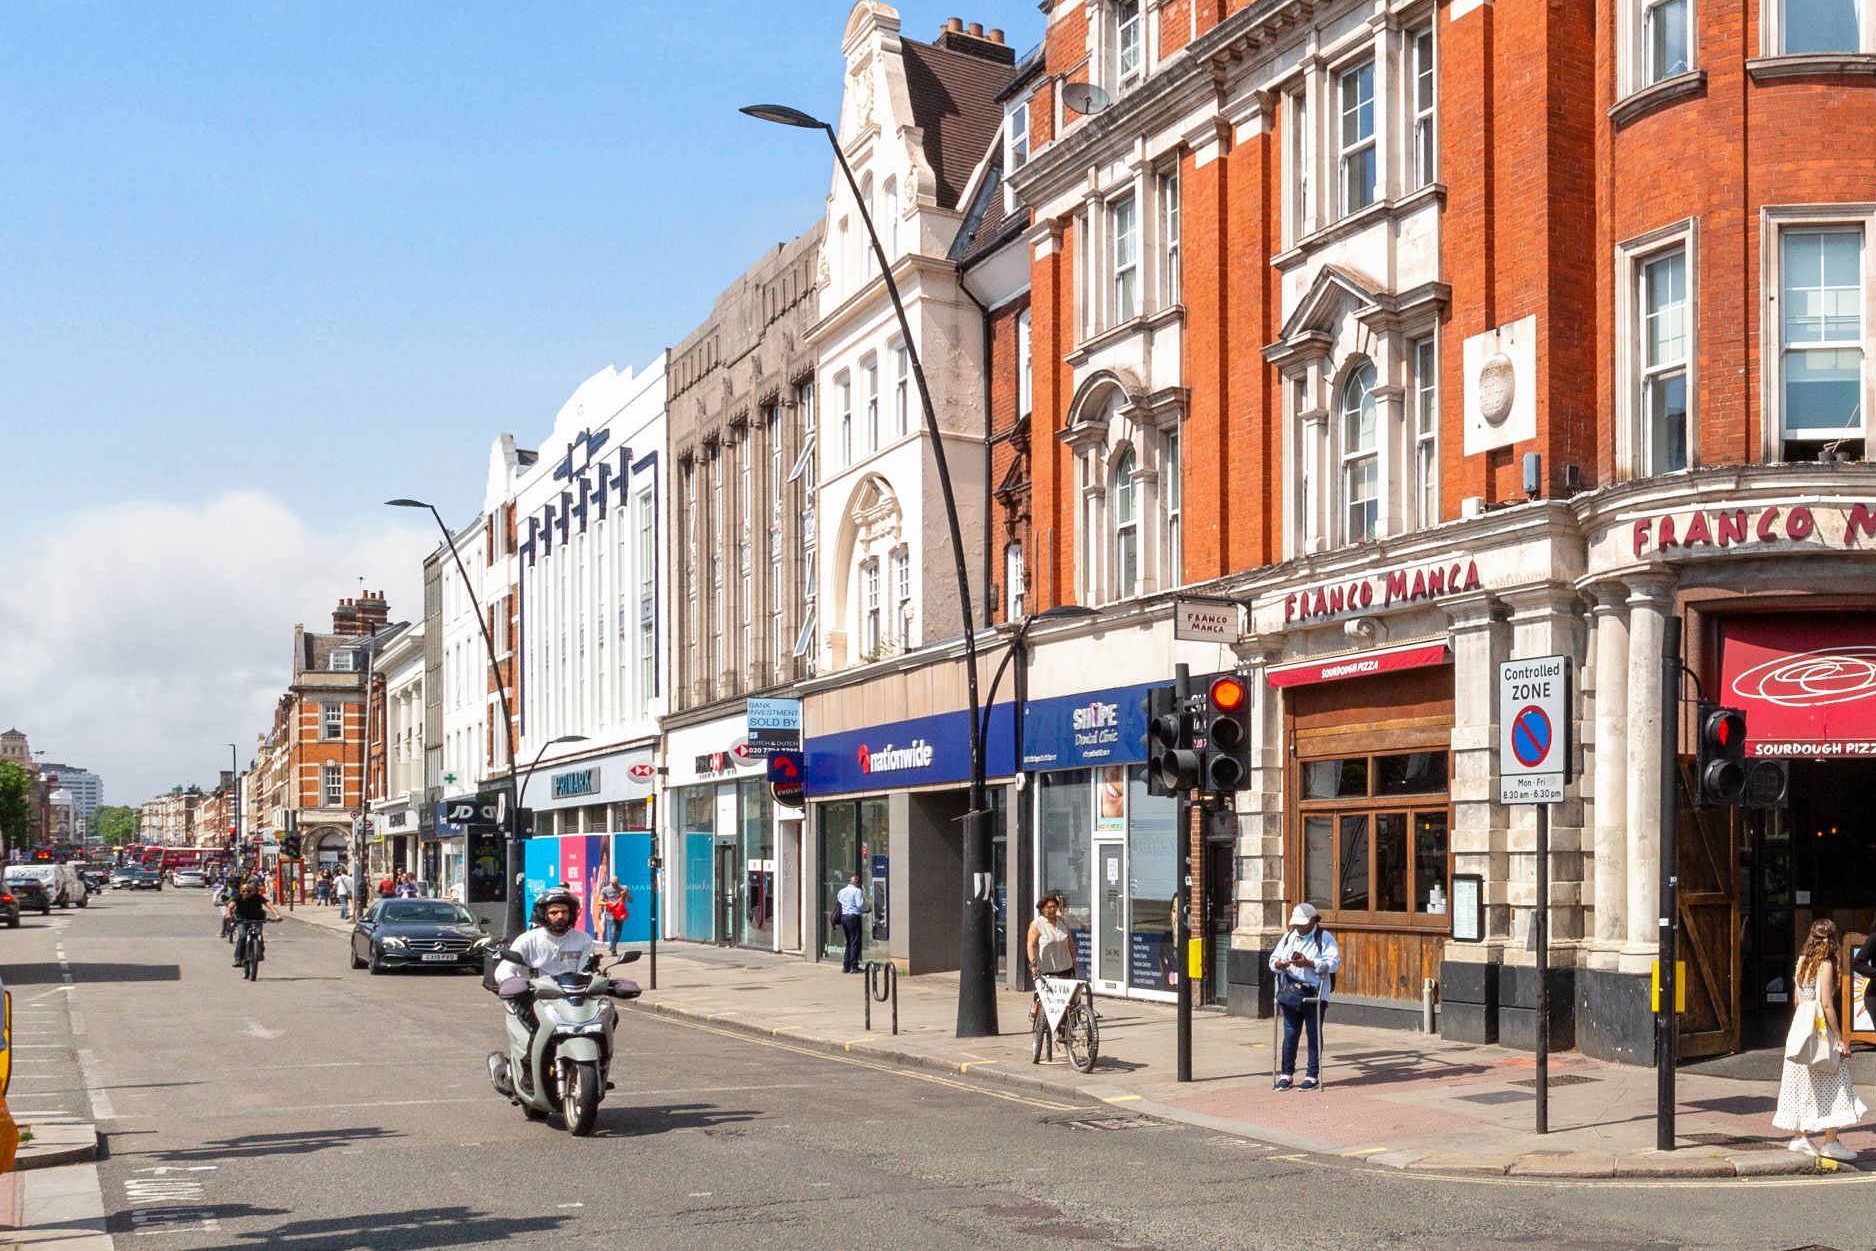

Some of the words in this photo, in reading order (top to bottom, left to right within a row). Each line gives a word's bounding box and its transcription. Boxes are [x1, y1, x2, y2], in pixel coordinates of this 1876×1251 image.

[1633, 506, 1813, 557] FRANCO
[1285, 581, 1373, 623] FRANCO
[1384, 560, 1481, 608] MANCA
[1187, 613, 1228, 623] FRANCO
[1191, 623, 1224, 633] MANCA
[1321, 662, 1358, 679] SOURDOUGH
[1358, 660, 1379, 673] PIZZA
[1504, 663, 1560, 681] Controlled
[1512, 682, 1551, 700] ZONE
[748, 709, 799, 717] INVESTMENT
[750, 718, 780, 727] SOLD
[783, 718, 798, 727] BY
[870, 739, 933, 773] nationwide
[1755, 743, 1842, 756] SOURDOUGH
[556, 769, 592, 797] PRIMARK
[1518, 779, 1532, 787] Mon
[1536, 778, 1546, 787] Fri
[1533, 789, 1550, 798] 6.30
[1550, 790, 1561, 800] pm
[449, 805, 474, 819] JD
